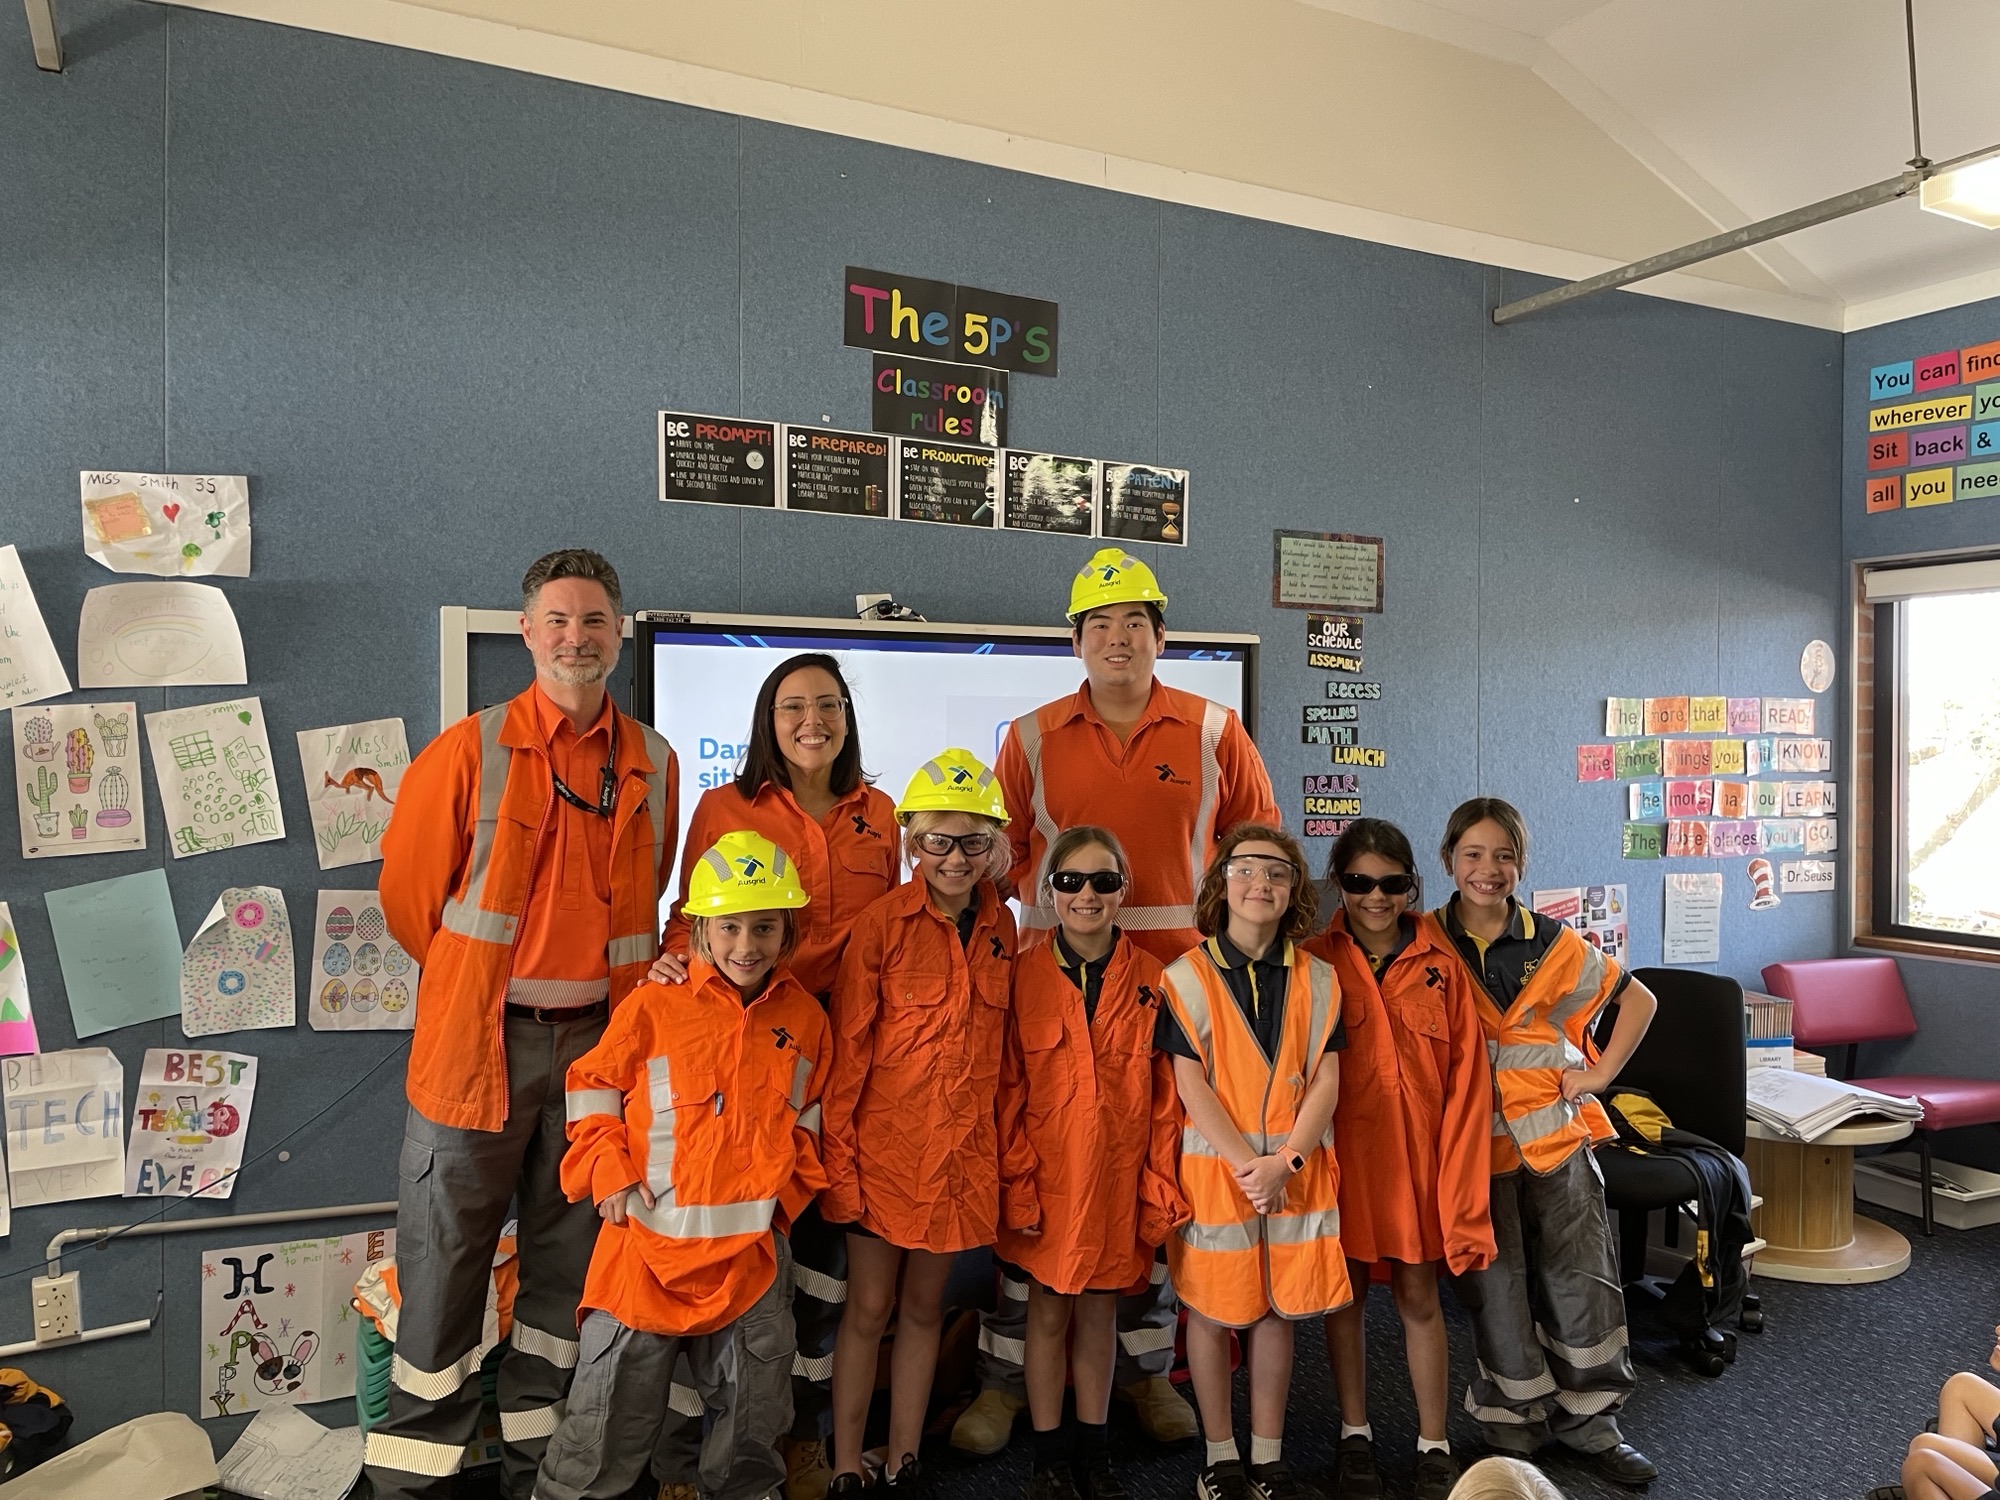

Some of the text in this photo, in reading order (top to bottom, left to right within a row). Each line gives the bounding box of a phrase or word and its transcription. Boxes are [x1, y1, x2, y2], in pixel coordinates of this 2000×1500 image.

[850, 284, 950, 346] The
[1875, 373, 1910, 390] You
[1920, 363, 1955, 381] can
[877, 368, 1003, 409] Classroom
[911, 408, 973, 436] rules
[1875, 404, 1967, 426] wherever
[676, 440, 714, 450] ARRIVE ON TIME
[696, 423, 771, 446] PROMPT!
[1873, 432, 1991, 459] Sit back &
[676, 452, 694, 460] UNPACK
[697, 453, 707, 461] AND
[722, 456, 734, 464] AWAY
[676, 460, 728, 471] QUICKLY AND QUIETLY
[811, 453, 822, 461] YOUR
[847, 457, 860, 466] READY
[676, 471, 687, 479] LINE
[698, 472, 711, 481] AFTER
[712, 474, 728, 482] RECESS
[730, 476, 740, 484] AND
[742, 477, 756, 485] LUNCH
[758, 478, 764, 486] BY
[798, 463, 810, 471] WEAR
[831, 467, 850, 475] UNIFORM
[822, 473, 833, 481] DAYS
[686, 480, 704, 489] SECOND
[706, 482, 717, 490] BELL
[798, 482, 811, 490] BRING
[841, 486, 851, 494] SUCH
[1872, 474, 2000, 502] all you nee
[1323, 622, 1349, 637] OUR
[1693, 706, 1720, 722] that
[1731, 711, 1755, 727] you
[325, 733, 342, 756] To
[1308, 726, 1352, 744] MATH
[1335, 747, 1385, 767] LUNCH
[1583, 754, 1610, 771] The
[1676, 752, 1709, 770] ings
[1715, 751, 1740, 769] you
[1783, 744, 1828, 759] KNOW.
[1640, 793, 1660, 808] he
[1752, 795, 1776, 806] you
[1787, 791, 1835, 808] LEARN,
[1631, 833, 1657, 850] The
[1671, 833, 1703, 847] oe
[1808, 825, 1834, 841] GO.
[738, 877, 766, 886] Ausgrid
[164, 1053, 248, 1086] BEST
[9, 1090, 120, 1151] TECH
[139, 1106, 230, 1132] TEACHER
[14, 1164, 98, 1203] EVER
